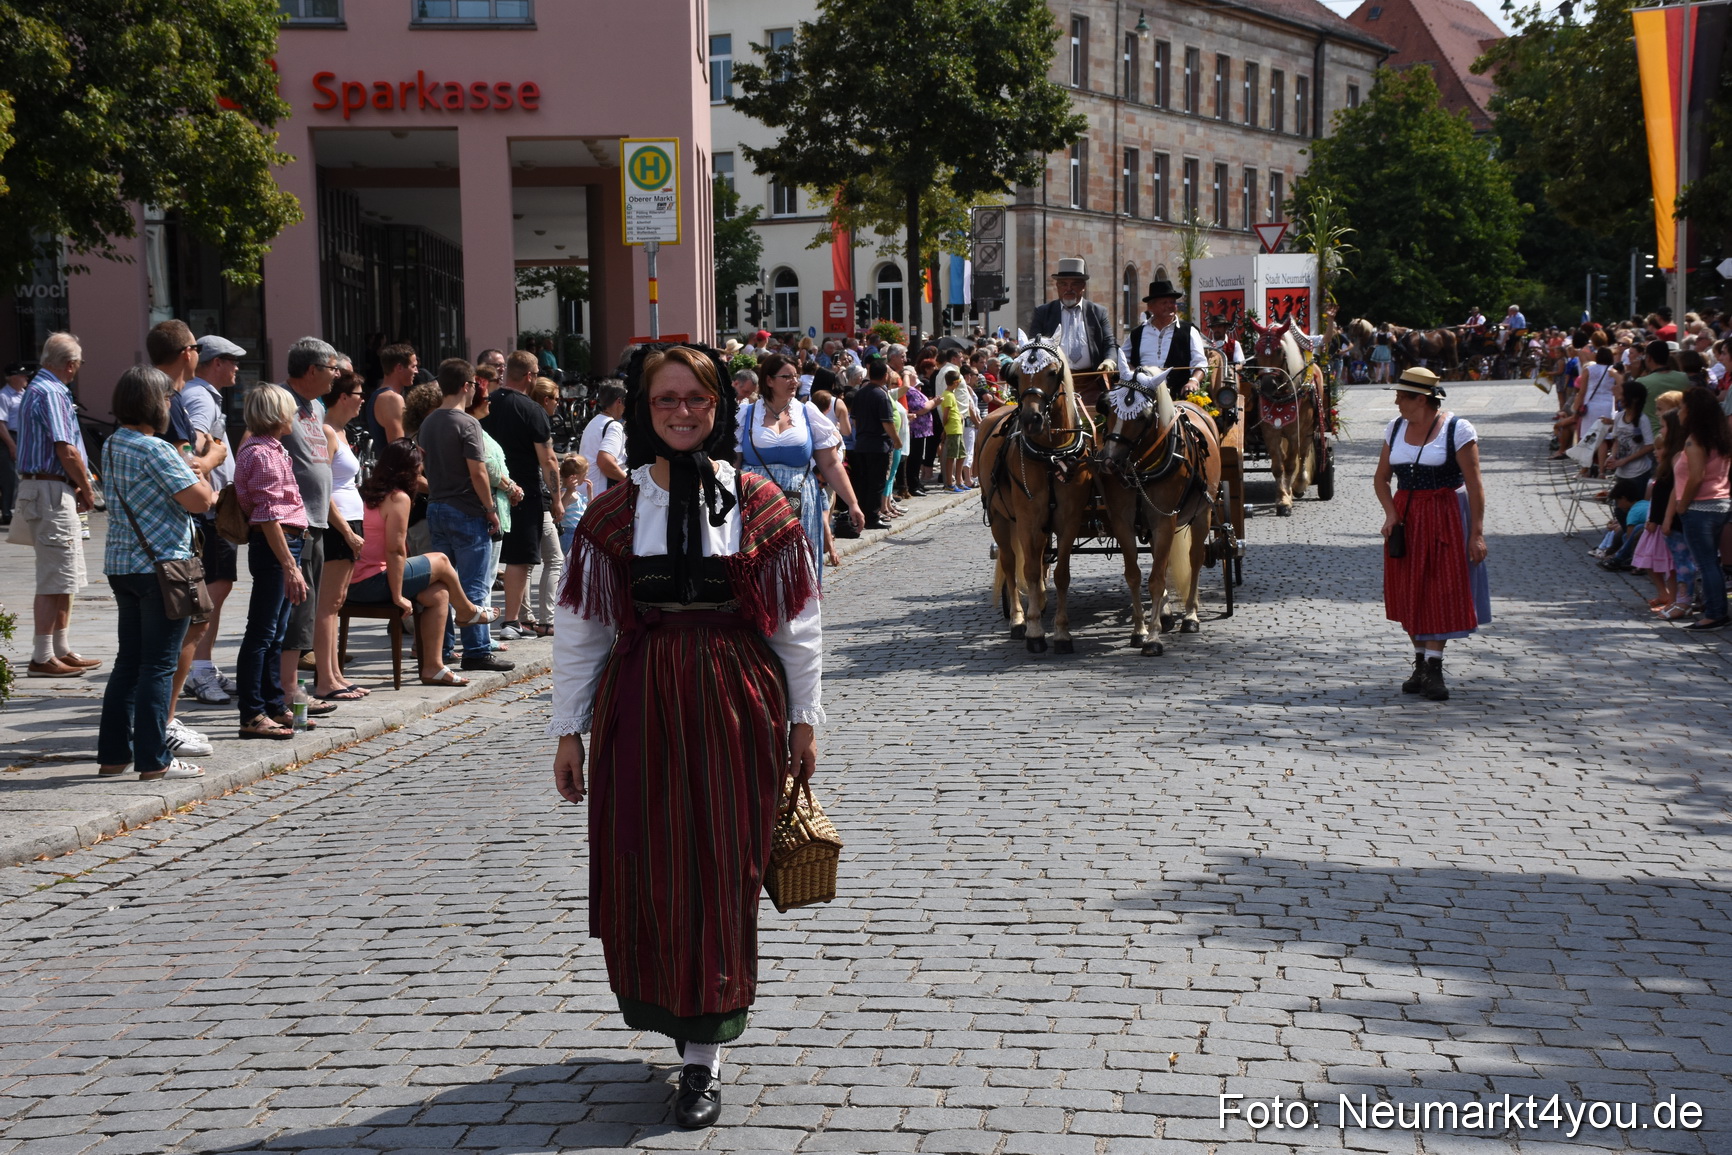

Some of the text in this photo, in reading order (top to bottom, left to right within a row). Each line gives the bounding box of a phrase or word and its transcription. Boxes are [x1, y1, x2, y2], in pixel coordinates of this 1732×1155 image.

[312, 70, 542, 120] Sparkasse
[1198, 275, 1245, 288] Stadt Neumarkt
[1265, 272, 1311, 285] Stadt Neumarkt
[15, 305, 67, 316] Ticketshop
